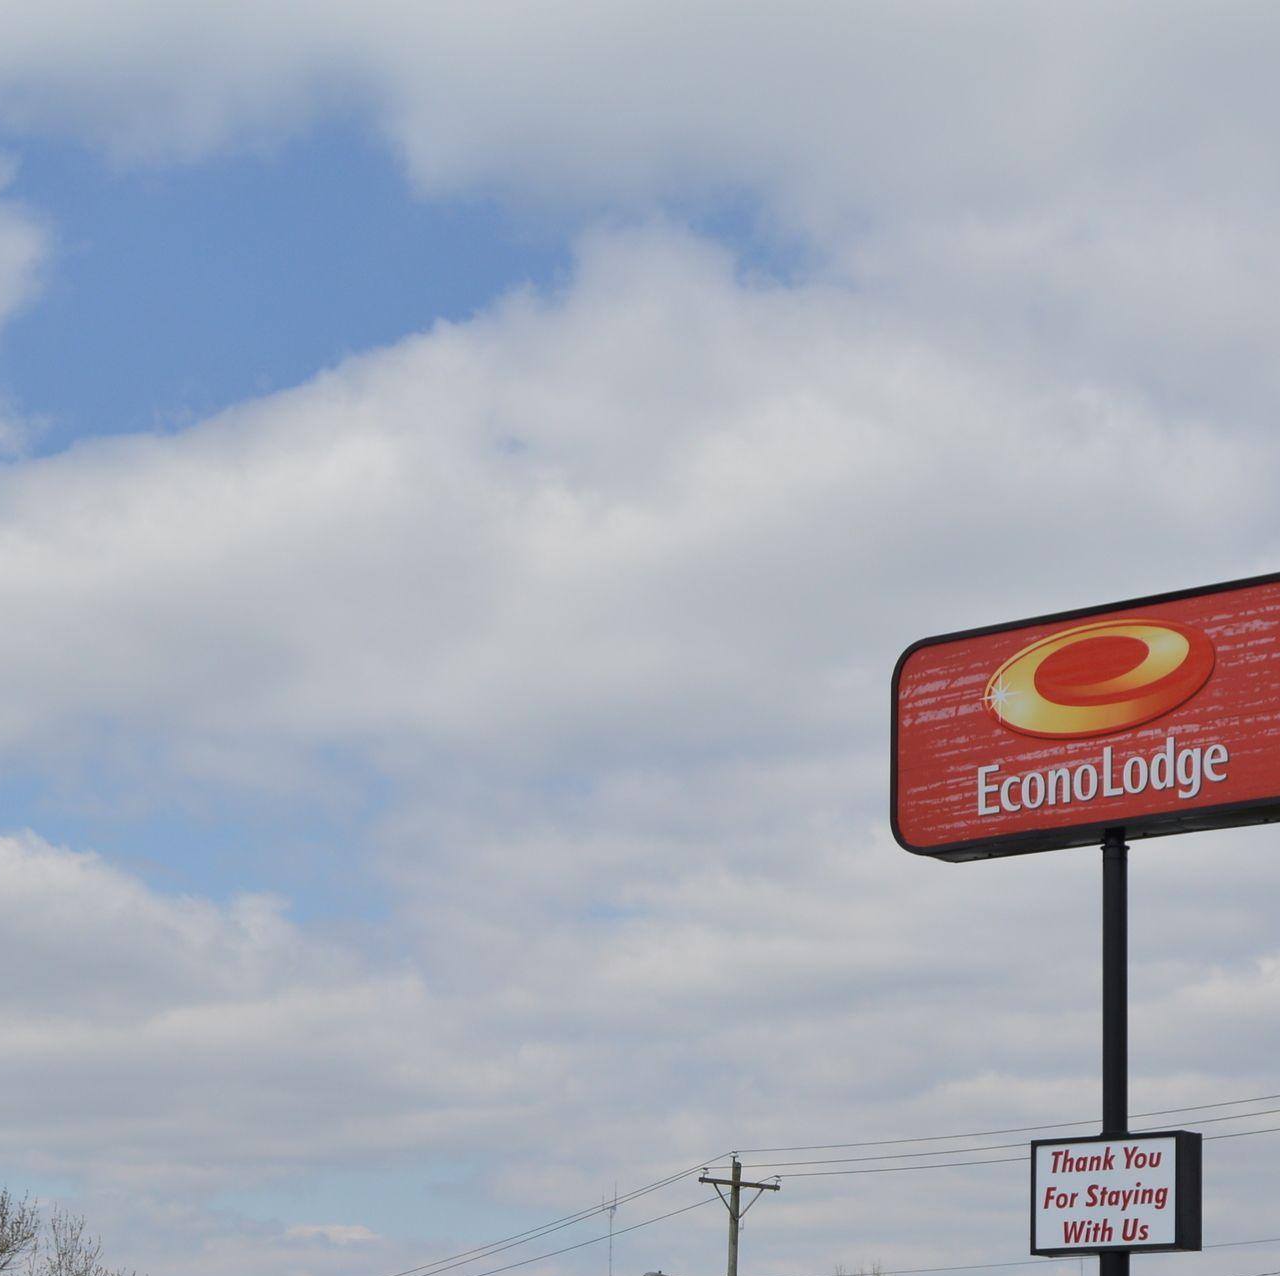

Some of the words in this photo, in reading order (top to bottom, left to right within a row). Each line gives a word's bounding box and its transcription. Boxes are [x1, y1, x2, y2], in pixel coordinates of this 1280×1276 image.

[977, 737, 1228, 816] EconoLodge
[1051, 1146, 1115, 1173] Thank
[1123, 1146, 1162, 1169] You
[1043, 1187, 1078, 1209] For
[1085, 1182, 1169, 1211] Staying
[1063, 1218, 1113, 1244] With
[1122, 1218, 1149, 1241] Us
